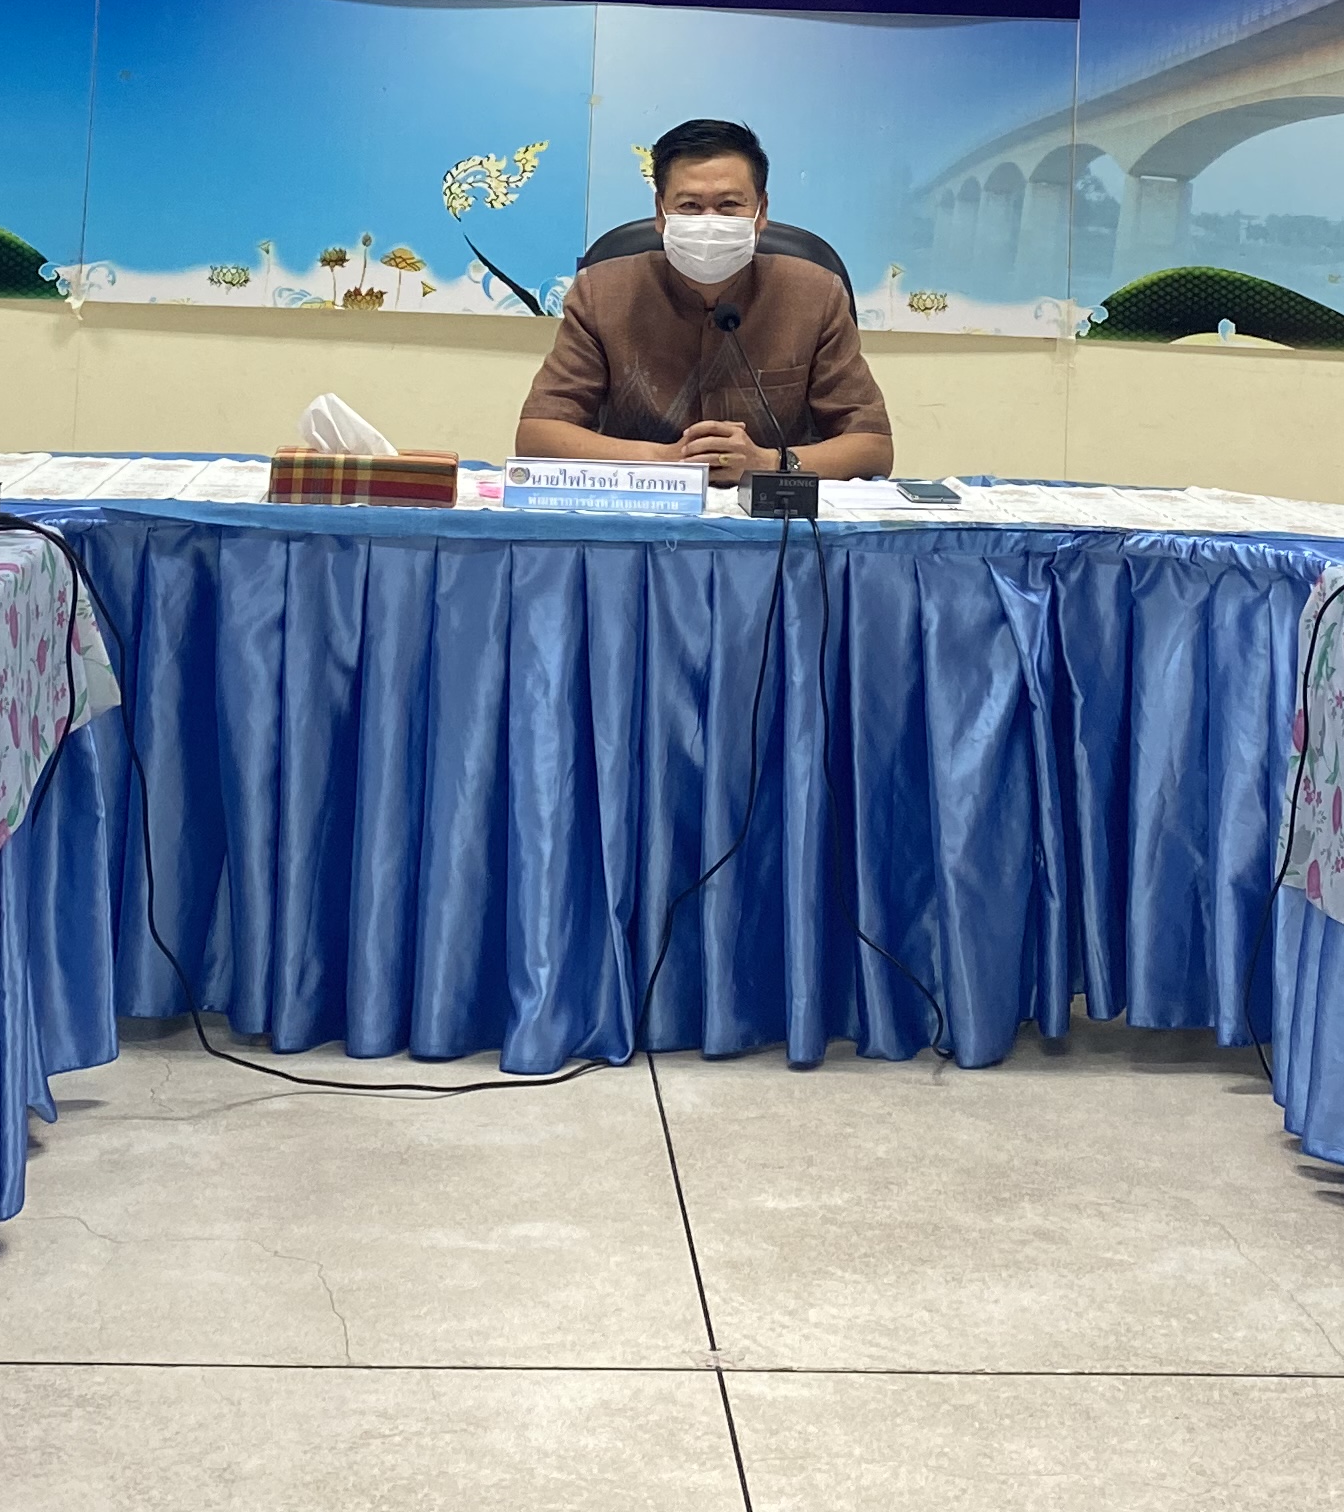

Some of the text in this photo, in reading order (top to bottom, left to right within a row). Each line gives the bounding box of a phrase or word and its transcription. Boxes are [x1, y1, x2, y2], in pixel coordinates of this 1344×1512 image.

[531, 467, 687, 491] นายไพโรจน์ โสภาพร
